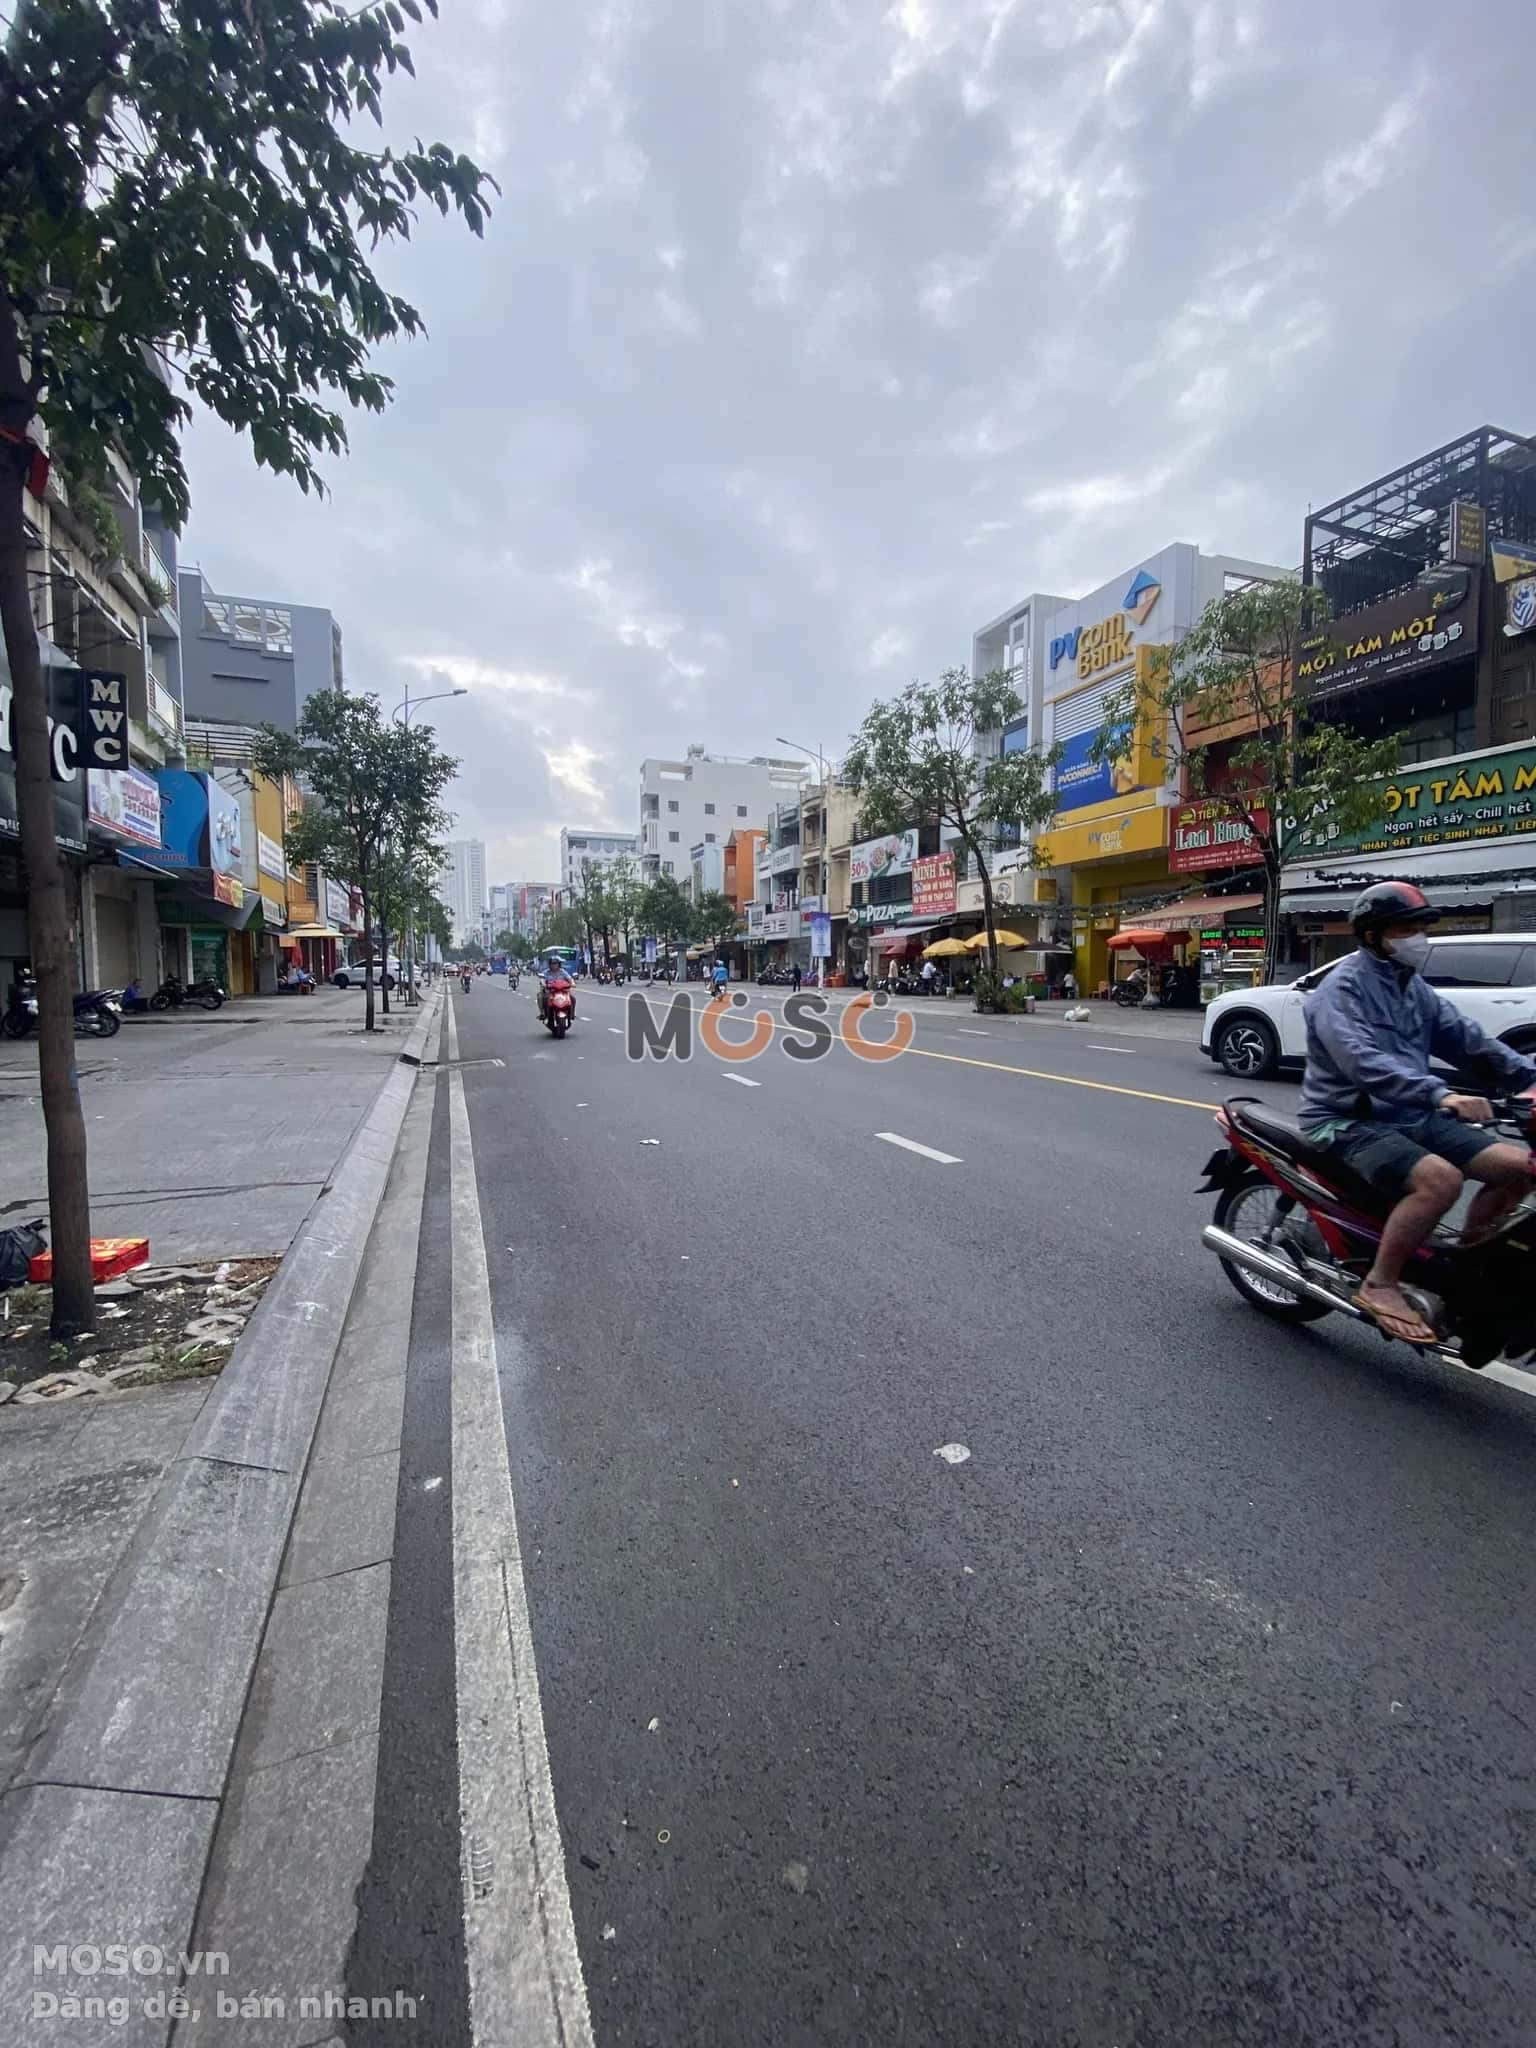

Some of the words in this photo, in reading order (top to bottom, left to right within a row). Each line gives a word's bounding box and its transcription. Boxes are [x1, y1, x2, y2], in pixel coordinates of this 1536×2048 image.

[1298, 647, 1337, 677] MỘT
[1345, 636, 1382, 660] TÁM
[1389, 615, 1437, 645] MỘT
[88, 678, 124, 762] MWC
[1430, 769, 1504, 805] TÁM
[1384, 820, 1414, 835] Ngon
[1418, 814, 1438, 828] hết
[1475, 805, 1502, 821] Chill
[1508, 798, 1531, 816] hết
[1444, 829, 1470, 840] SINH
[1175, 828, 1211, 851] Lan
